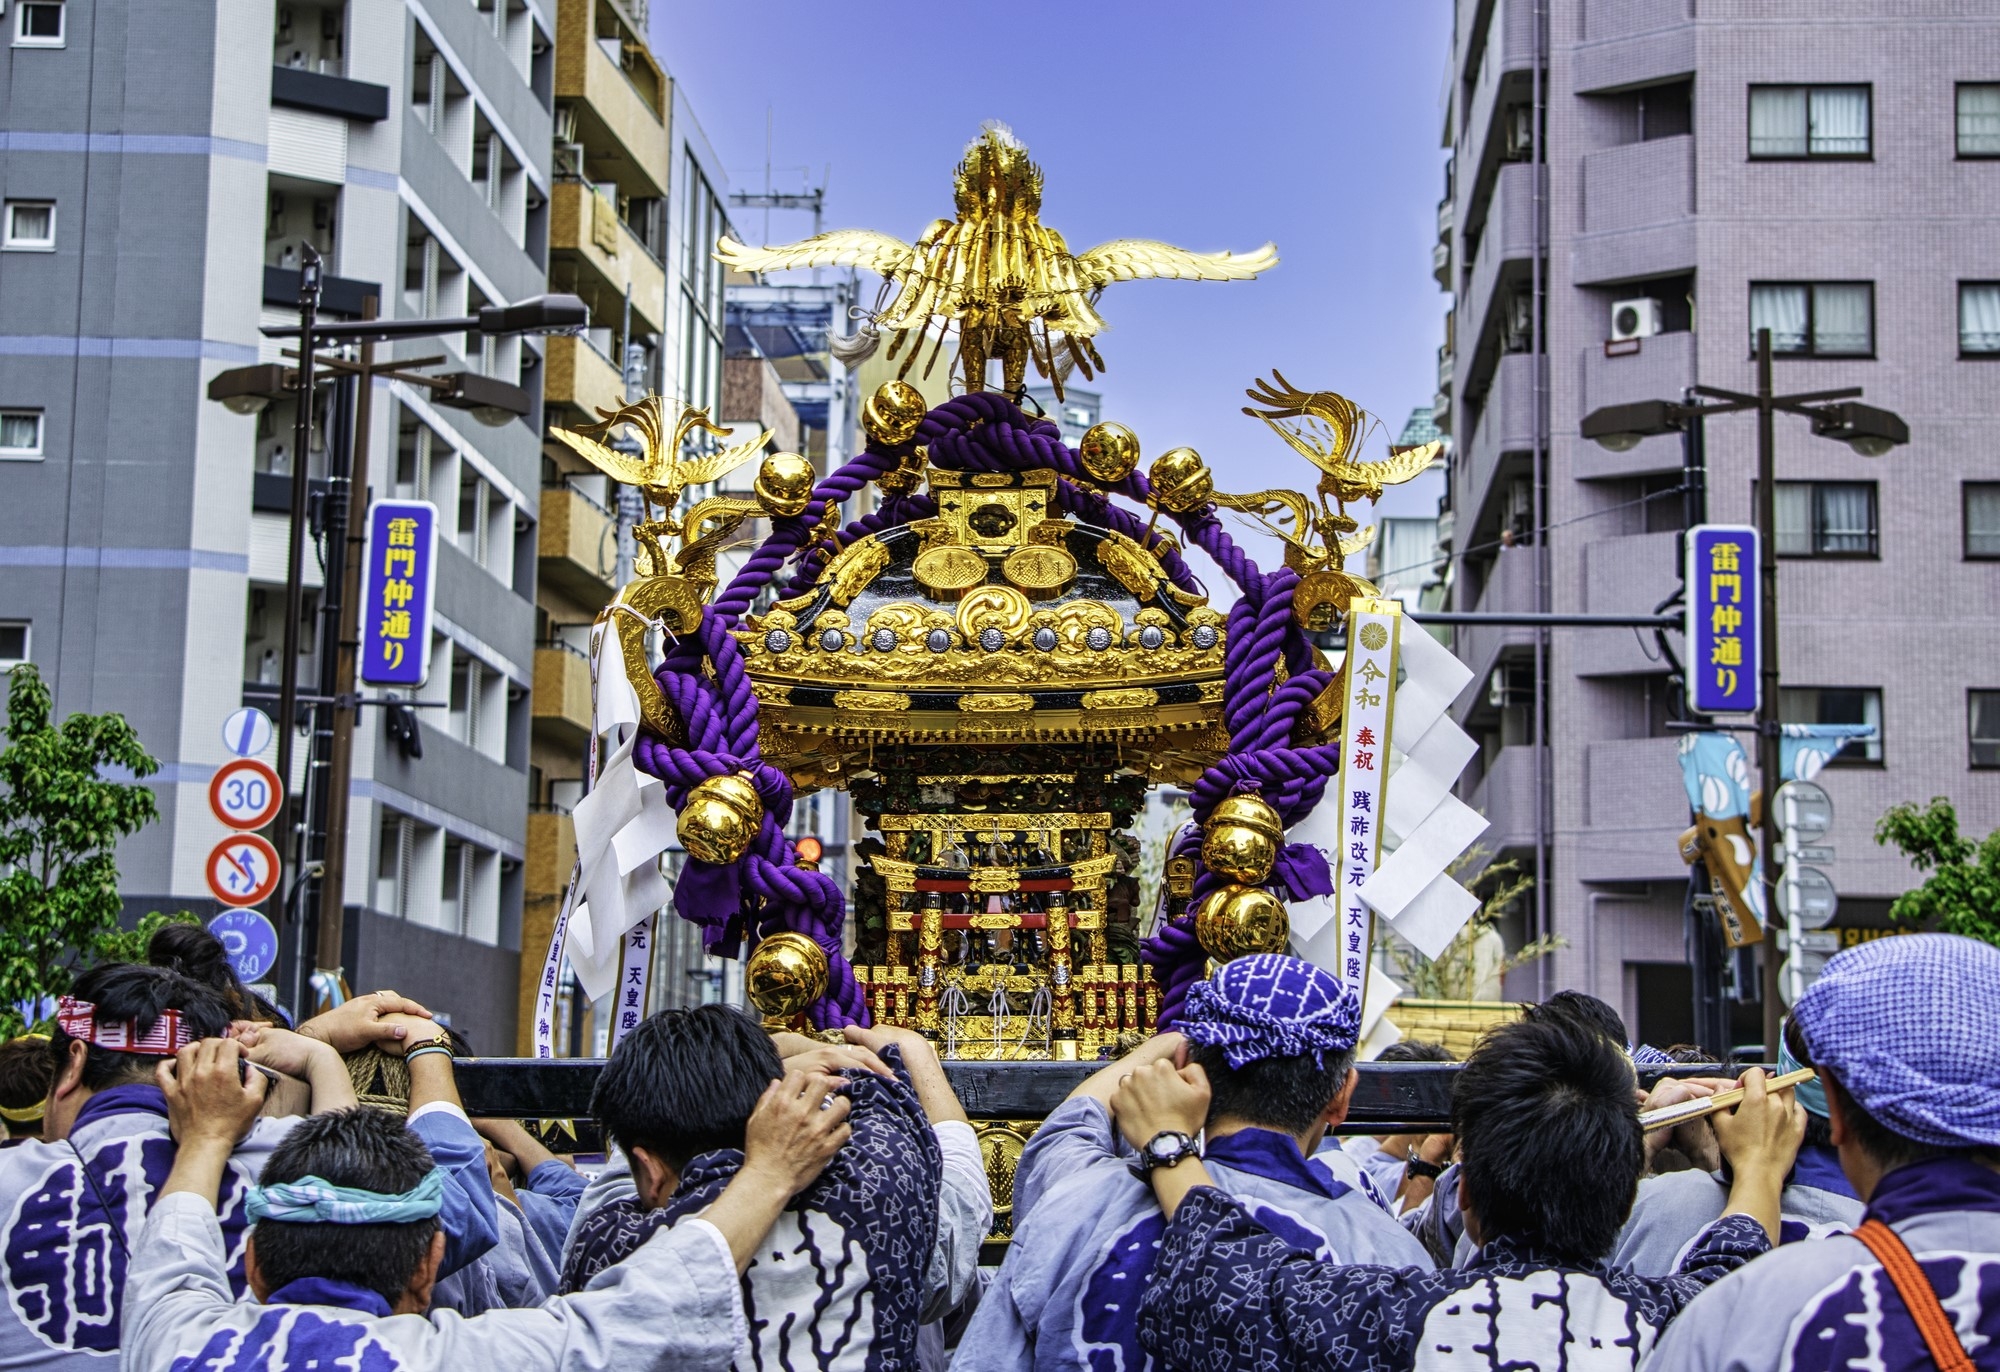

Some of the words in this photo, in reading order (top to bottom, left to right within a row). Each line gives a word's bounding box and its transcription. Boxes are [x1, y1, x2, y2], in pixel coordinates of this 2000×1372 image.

[379, 517, 419, 670] 雷門仲通り
[1709, 542, 1742, 697] 雷門仲通り
[1353, 657, 1386, 710] 令和
[1352, 726, 1376, 771] 奉祝
[226, 779, 266, 810] 30
[1347, 790, 1371, 887] 践祚改元
[619, 966, 643, 1039] 天皇陛
